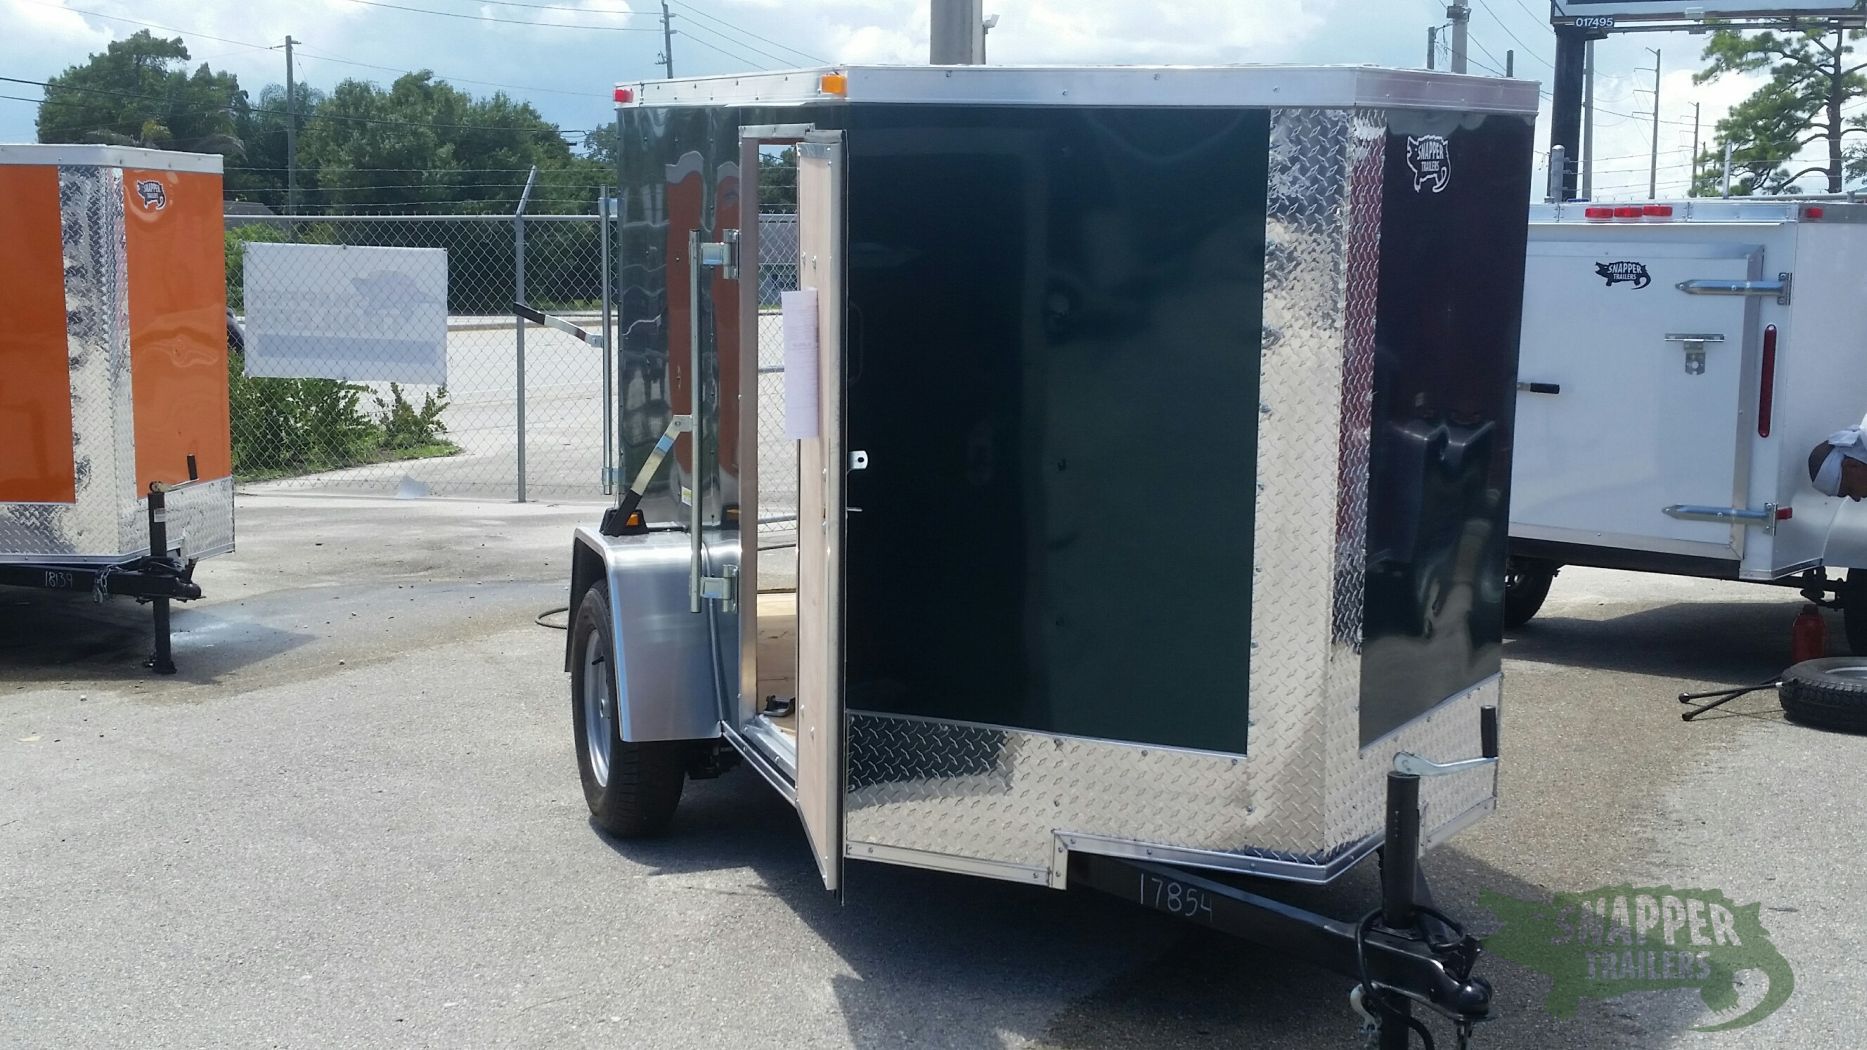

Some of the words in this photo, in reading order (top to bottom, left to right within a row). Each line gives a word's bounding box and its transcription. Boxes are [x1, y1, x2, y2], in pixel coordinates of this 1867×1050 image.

[1575, 17, 1614, 27] 017495
[1416, 141, 1444, 160] SNAPPER
[1607, 262, 1643, 274] SNAPPER
[45, 570, 73, 588] 18139
[1140, 873, 1213, 922] 17854
